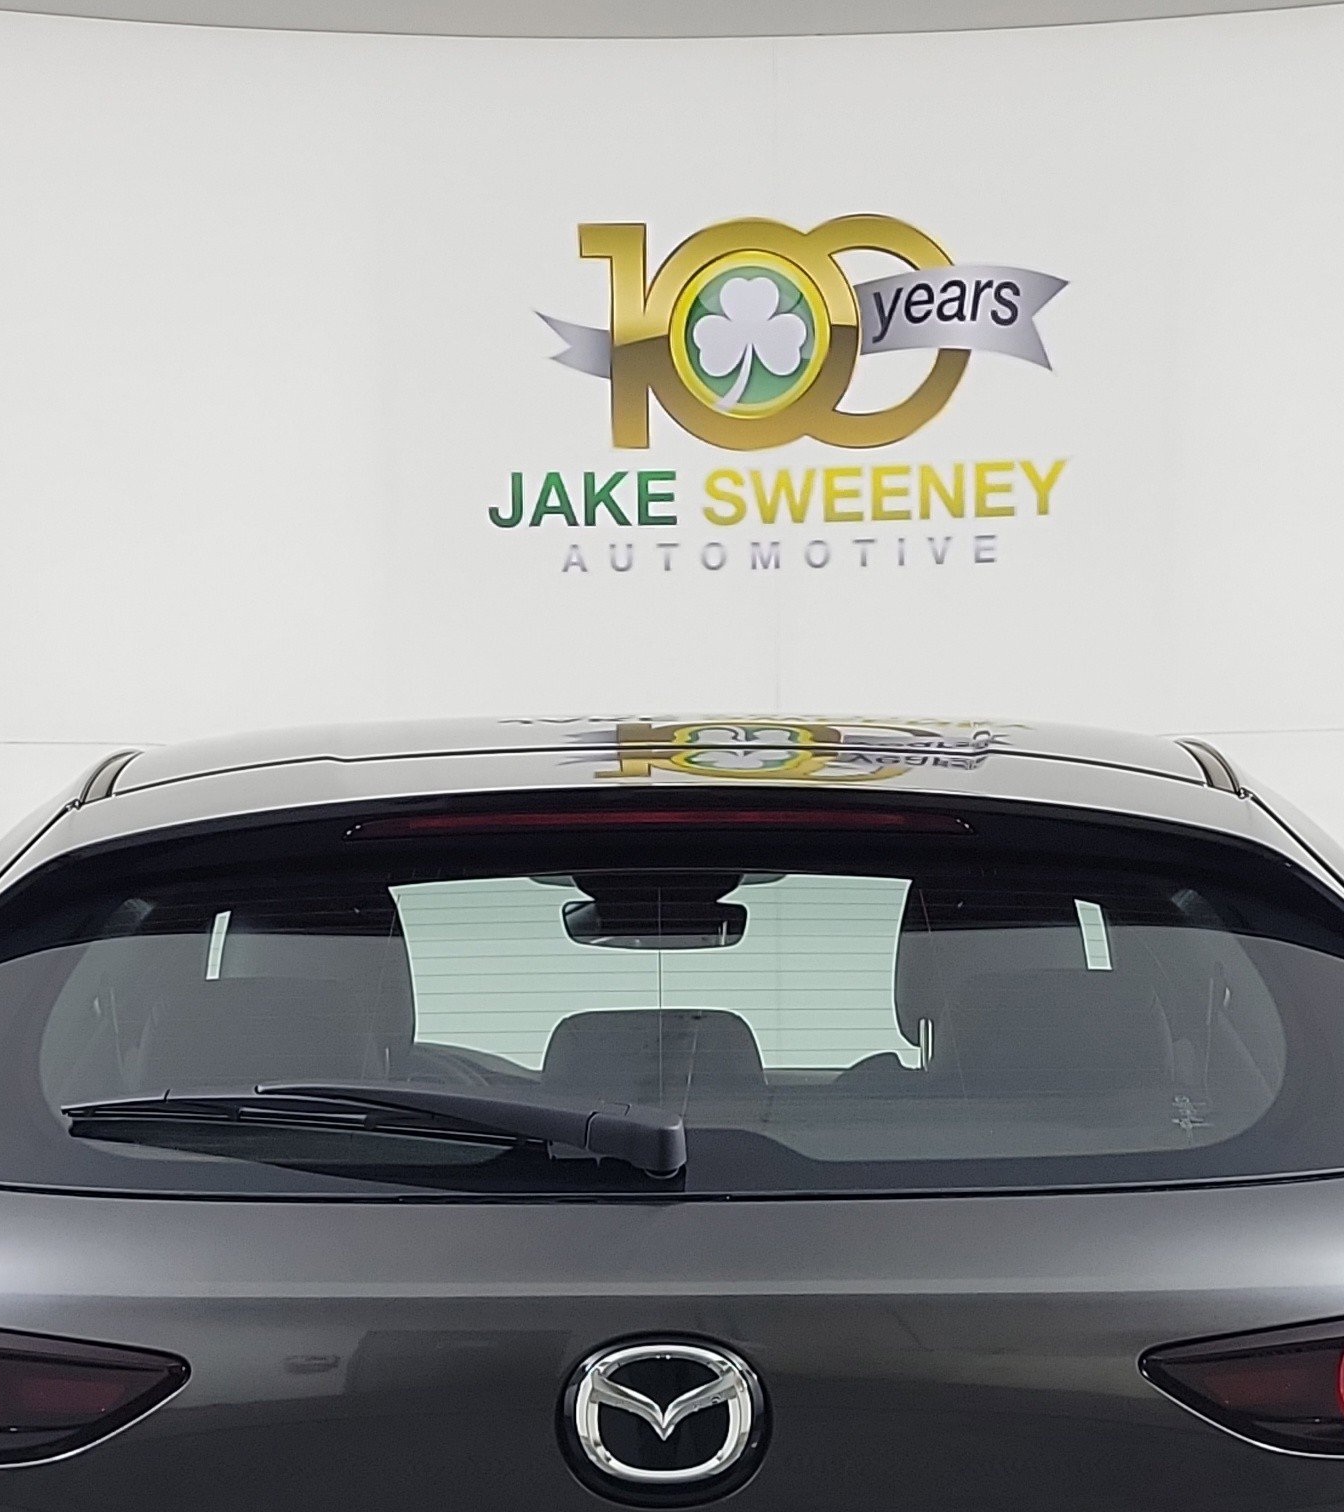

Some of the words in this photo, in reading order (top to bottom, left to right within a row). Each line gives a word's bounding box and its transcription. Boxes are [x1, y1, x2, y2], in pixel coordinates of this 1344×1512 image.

[578, 213, 970, 451] 100
[871, 276, 1022, 344] years
[488, 470, 678, 528] JAKE
[703, 459, 1068, 526] SWEENEY
[562, 534, 998, 573] AUTOMOTIVE
